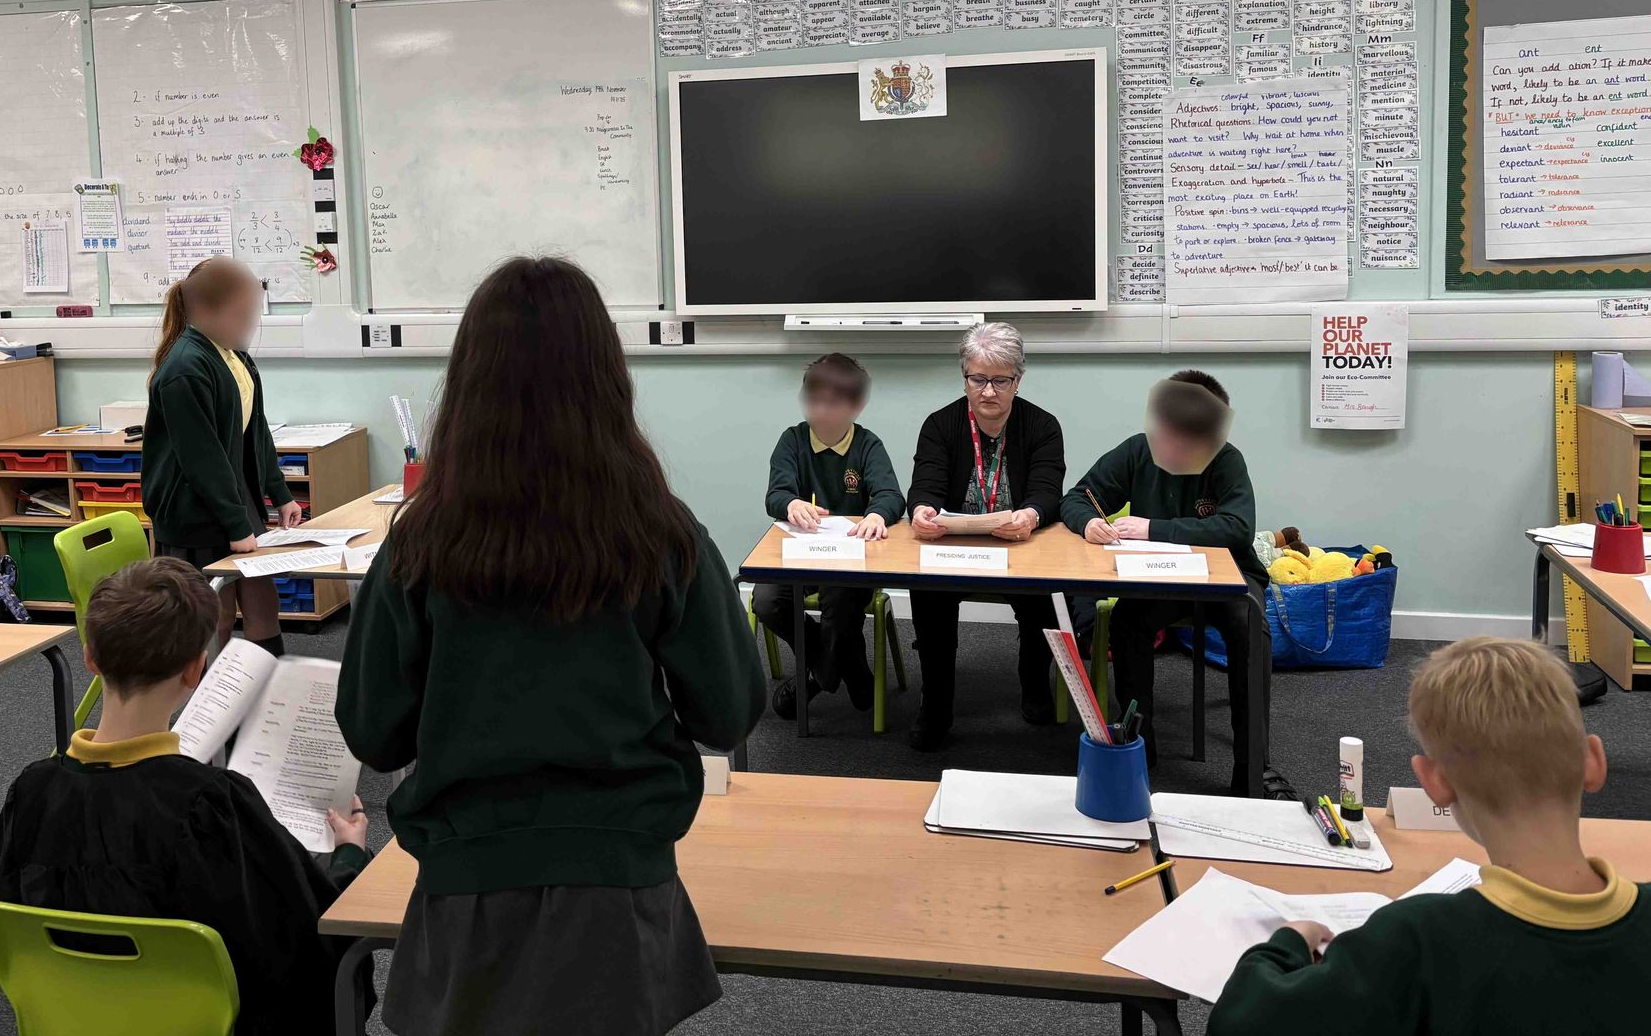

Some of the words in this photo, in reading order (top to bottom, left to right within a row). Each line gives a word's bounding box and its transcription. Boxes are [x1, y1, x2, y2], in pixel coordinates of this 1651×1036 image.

[808, 1, 840, 9] apparent
[1239, 0, 1285, 9] explanation
[1369, 1, 1398, 9] library
[759, 8, 790, 16] although
[913, 5, 941, 14] bargain
[1186, 9, 1219, 17] different
[1310, 7, 1335, 16] height
[662, 14, 701, 22] accidentally
[859, 14, 891, 22] available
[966, 14, 994, 22] breathe
[1022, 14, 1039, 23] busy
[1069, 15, 1103, 23] cemetery
[1133, 12, 1154, 20] circle
[1365, 19, 1403, 27] lightning
[1187, 27, 1218, 35] difficult
[1302, 24, 1343, 32] hindrance
[809, 32, 846, 41] appreciate
[861, 31, 889, 39] average
[1253, 34, 1265, 43] Ff
[1368, 35, 1392, 43] Mm
[664, 44, 701, 52] accompany
[1184, 44, 1222, 53] disappear
[1310, 41, 1338, 49] history
[1585, 44, 1602, 53] ent
[1246, 50, 1279, 59] familiar
[1363, 50, 1409, 58] marvellous
[1519, 49, 1539, 58] ant
[1122, 62, 1166, 70] community
[1248, 65, 1277, 75] famous
[1493, 65, 1511, 76] Can
[1518, 66, 1534, 77] you
[1542, 63, 1561, 72] add
[1600, 58, 1613, 70] If
[1617, 58, 1626, 67] it
[1371, 68, 1406, 77] material
[1122, 78, 1166, 86] competition
[1370, 82, 1406, 91] medicine
[1491, 82, 1517, 93] word,
[1524, 79, 1548, 91] likely
[1554, 78, 1563, 87] to
[1568, 77, 1580, 86] be
[1604, 74, 1620, 84] ant
[155, 90, 161, 102] if
[165, 93, 188, 101] number
[1128, 93, 1163, 101] complete
[1371, 96, 1405, 104] mention
[1490, 97, 1502, 108] If
[1531, 94, 1558, 107] likely
[1563, 94, 1572, 103] to
[1578, 93, 1589, 101] be
[1608, 91, 1623, 101] ent
[1230, 102, 1259, 114] bright,
[1541, 110, 1560, 119] need
[1567, 110, 1576, 119] to
[1583, 107, 1607, 117] know
[1171, 118, 1212, 130] Rhetorical
[1258, 116, 1277, 125] How
[1281, 115, 1303, 124] could
[1168, 136, 1188, 144] want
[1243, 131, 1259, 142] Why
[1265, 131, 1283, 139] wait
[1285, 131, 1296, 139] at
[1299, 129, 1320, 138] home
[1364, 131, 1414, 140] mischievous
[1501, 127, 1540, 137] hesitant
[1597, 138, 1634, 147] excellent
[1168, 150, 1203, 158] adventure
[1219, 148, 1247, 158] waiting
[1251, 146, 1271, 157] right
[1376, 146, 1405, 154] muscle
[238, 154, 254, 166] gives
[1600, 154, 1634, 163] innocent
[1170, 162, 1204, 174] Sensory
[1210, 162, 1236, 171] detail
[1375, 160, 1393, 168] Nn
[1500, 158, 1545, 170] expectant
[156, 168, 178, 176] answer
[1373, 174, 1404, 183] natural
[1499, 175, 1537, 184] tolerant
[1171, 177, 1225, 190] Exaggeration
[1233, 193, 1253, 203] place
[1273, 190, 1299, 199] Earth!
[1372, 189, 1406, 197] naughty
[1500, 191, 1534, 199] radiant
[370, 202, 391, 210] Oscar
[1369, 205, 1409, 213] necessary
[1500, 205, 1545, 214] observant
[1368, 221, 1409, 231] neighbour
[1501, 221, 1540, 229] relevant
[1553, 219, 1588, 227] relevance
[1131, 230, 1164, 239] curiosity
[1138, 245, 1153, 253] Dd
[1130, 272, 1159, 281] definite
[1614, 303, 1649, 311] identity
[1323, 316, 1368, 330] HELP
[1323, 329, 1363, 342] OUR
[1323, 342, 1392, 356] PLANET
[1322, 356, 1392, 369] TODAY!
[364, 551, 377, 559] WIT
[1146, 561, 1177, 569] WINGER
[1432, 805, 1451, 816] DE
